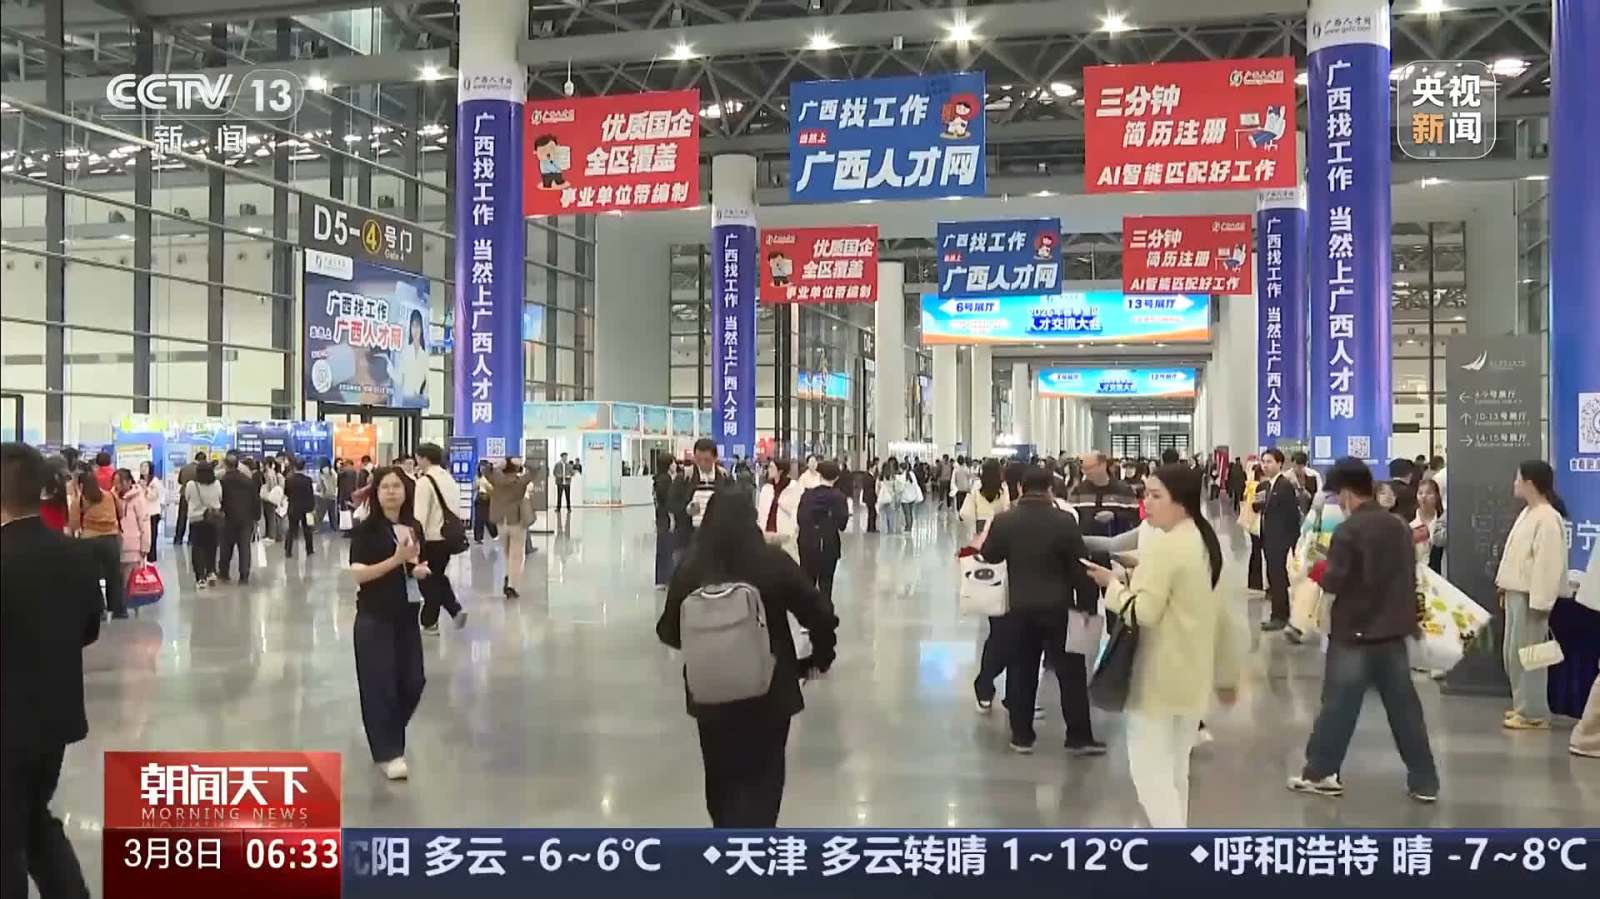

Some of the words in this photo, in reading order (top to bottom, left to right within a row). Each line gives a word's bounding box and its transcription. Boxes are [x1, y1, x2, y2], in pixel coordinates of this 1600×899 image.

[798, 93, 930, 129] 广西找工作
[1095, 84, 1181, 117] 三分钟
[601, 108, 694, 142] 优质国企
[1122, 117, 1227, 148] 简历注册
[1326, 59, 1353, 192] 广西找工作
[473, 112, 494, 226] 广西找工作
[584, 143, 678, 176] 全区覆盖
[796, 145, 980, 192] 广西人才网
[1097, 159, 1277, 186] AI智能匹配好工作
[560, 181, 690, 208] 事业单位带编制
[813, 238, 875, 258] 优质国企
[943, 230, 1027, 253] 广西找工作
[1130, 228, 1183, 249] 三分钟
[724, 233, 739, 308] 广西找工作
[802, 260, 864, 280] 全区覆盖
[1146, 250, 1210, 268] 简历注册
[1267, 217, 1282, 299] 广西找工作
[786, 284, 872, 300] 事业单位带编制
[942, 263, 1058, 292] 广西人才网
[1130, 277, 1240, 291] AI智能匹配好工作
[327, 290, 389, 323] 广西找工作
[956, 302, 995, 313] 6号展厅
[1128, 298, 1176, 309] 13号展厅
[1328, 206, 1354, 419] 当然上广西人才网
[333, 317, 403, 351] 广西人才网
[472, 239, 493, 423] 当然上广西人才网
[724, 316, 738, 436] 当然上广西人才网
[1267, 307, 1282, 437] 当然上广西人才网
